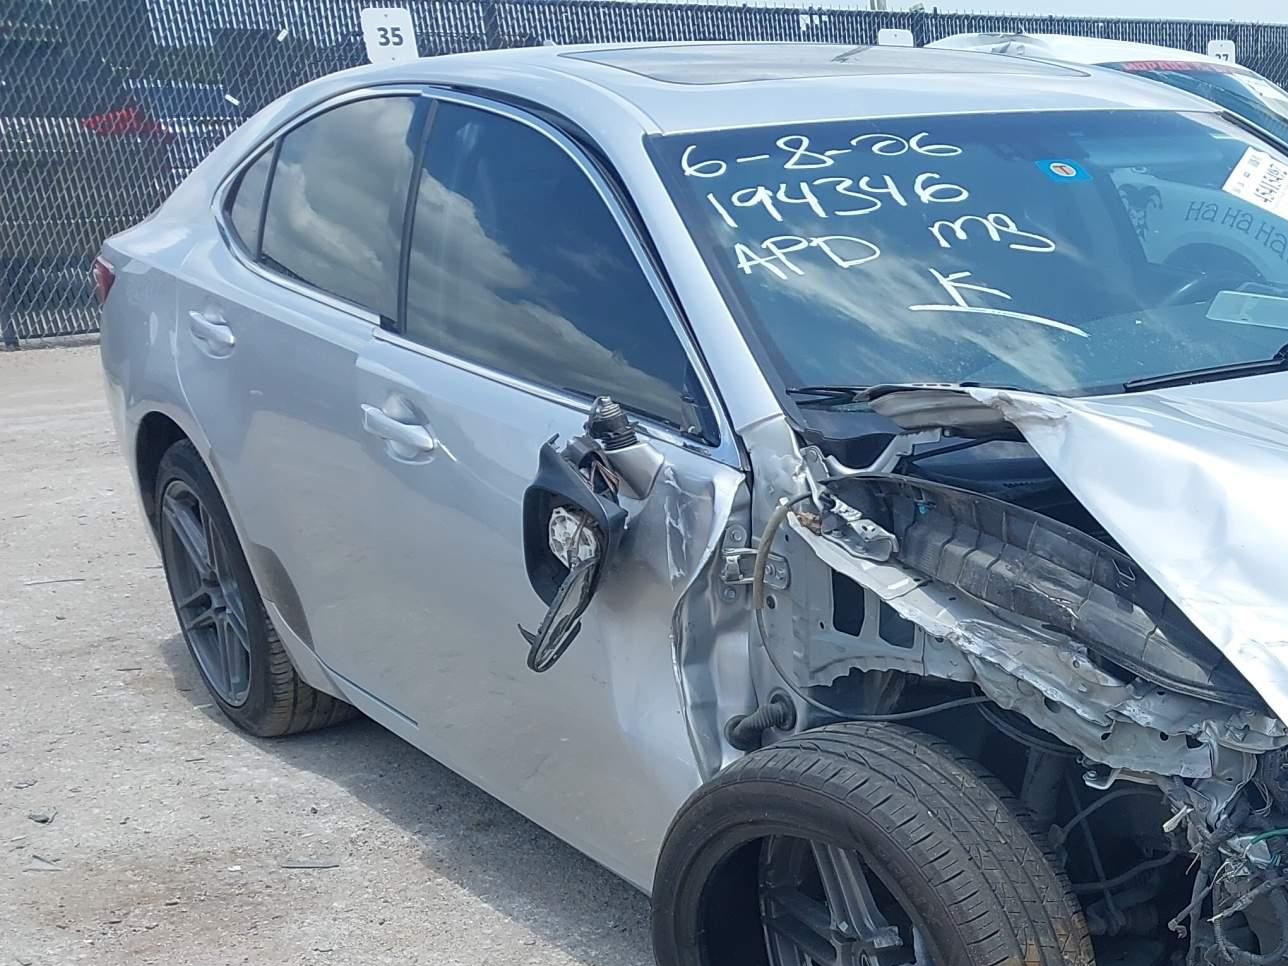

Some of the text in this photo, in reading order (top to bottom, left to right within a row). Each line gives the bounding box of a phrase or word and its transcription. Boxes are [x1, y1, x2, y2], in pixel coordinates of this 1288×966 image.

[376, 26, 404, 47] 35
[706, 172, 970, 229] 194346
[734, 235, 881, 281] APD
[928, 267, 1013, 308] K
